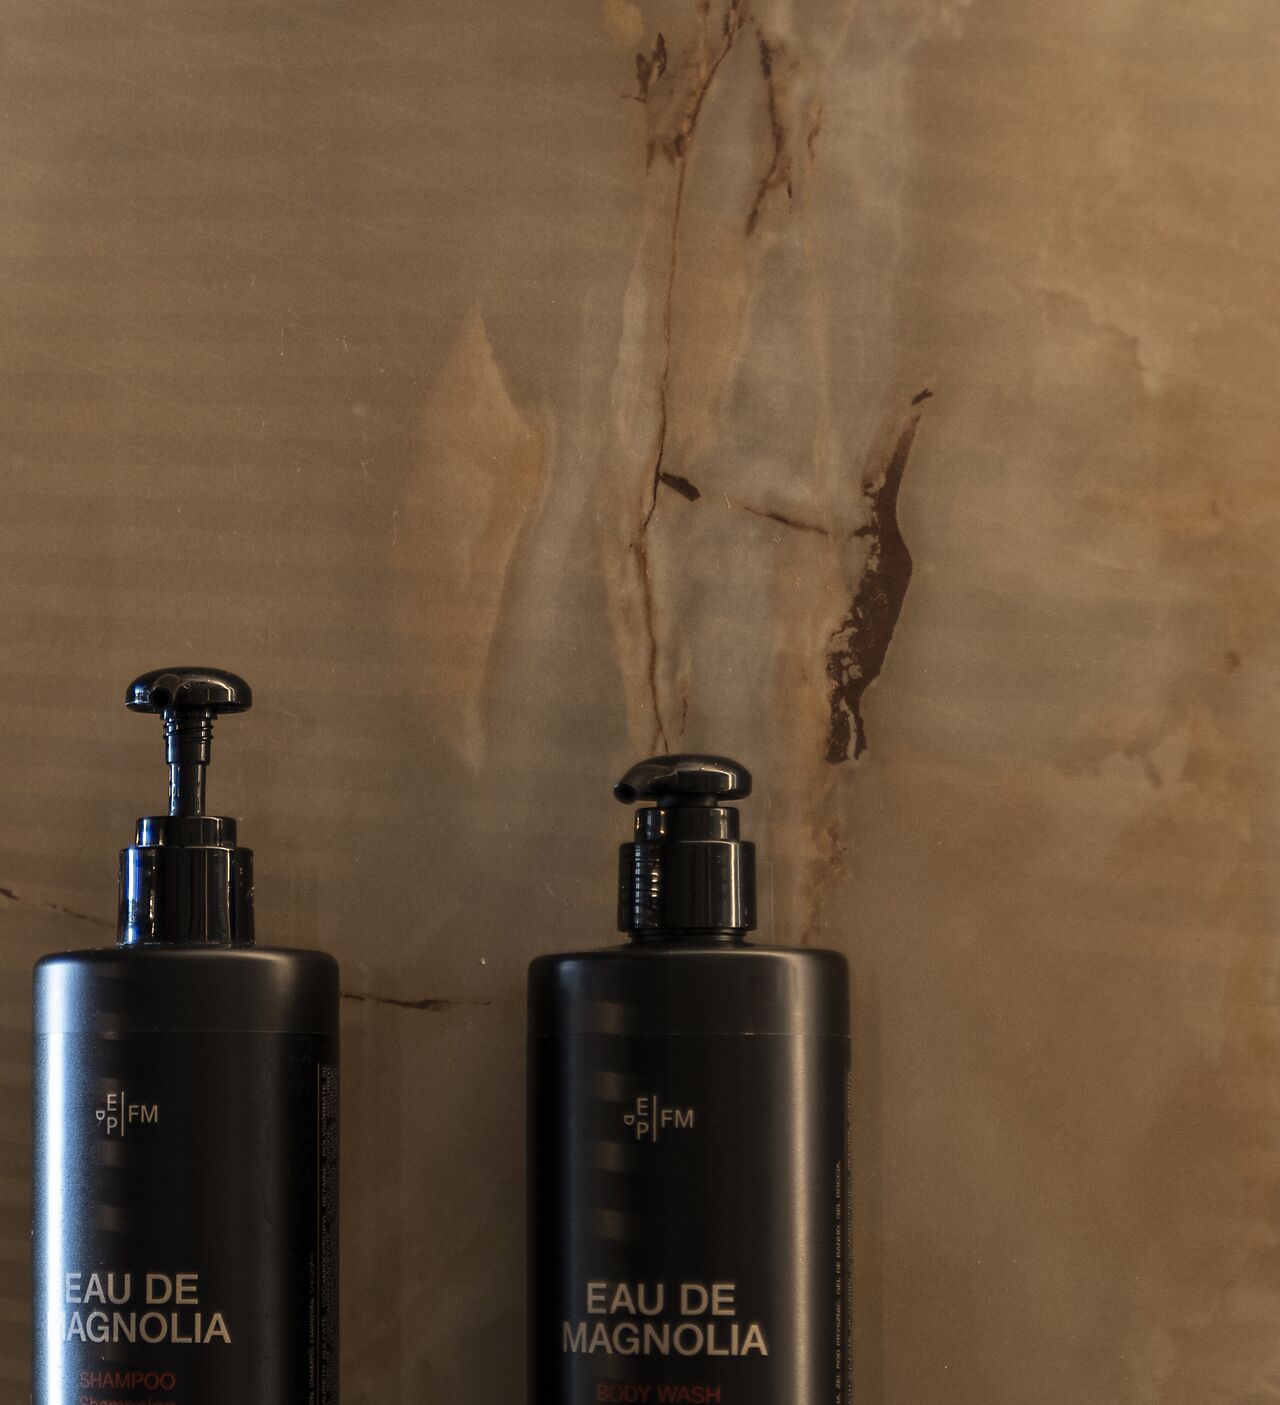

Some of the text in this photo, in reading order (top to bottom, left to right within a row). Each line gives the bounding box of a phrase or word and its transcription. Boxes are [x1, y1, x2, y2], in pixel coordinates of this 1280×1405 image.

[128, 1104, 159, 1124] FM
[660, 1109, 694, 1129] FM
[65, 1273, 199, 1305] EAU DE
[586, 1282, 736, 1316] EAU DE
[62, 1311, 232, 1344] AGNOLIA
[562, 1321, 769, 1357] MAGNOLIA
[79, 1371, 176, 1391] SHAMPOO
[596, 1384, 721, 1404] BODY WASH
